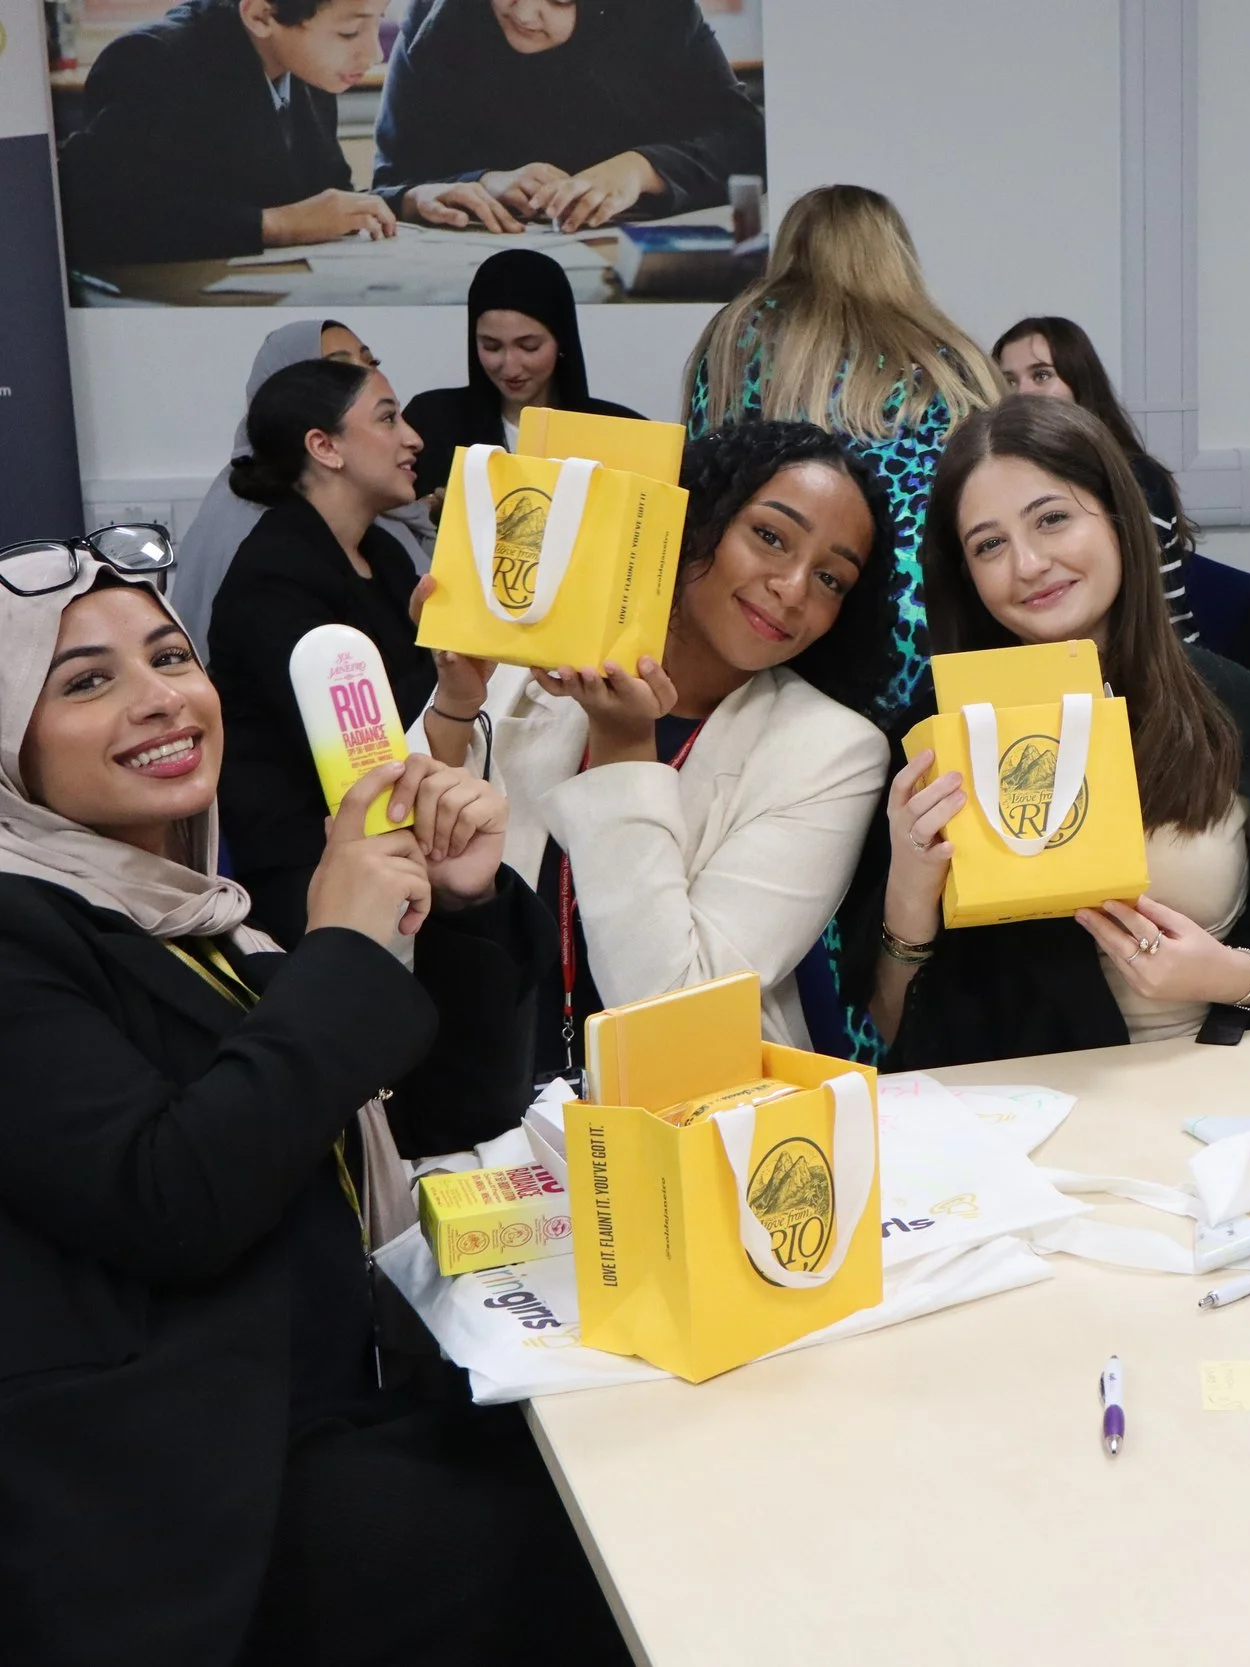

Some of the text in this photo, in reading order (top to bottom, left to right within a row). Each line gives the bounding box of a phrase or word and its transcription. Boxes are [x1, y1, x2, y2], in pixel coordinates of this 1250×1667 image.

[329, 679, 382, 732] RIO
[343, 724, 387, 748] RADIANCE
[1039, 789, 1053, 804] fro
[590, 1138, 607, 1159] GOT
[505, 1167, 543, 1199] RADIANCE
[593, 1161, 609, 1195] YOU'VE
[597, 1210, 616, 1248] FLAUNT
[660, 1177, 672, 1261] @soldejaneiro
[769, 1216, 825, 1271] RIO
[601, 1263, 618, 1287] LOVE
